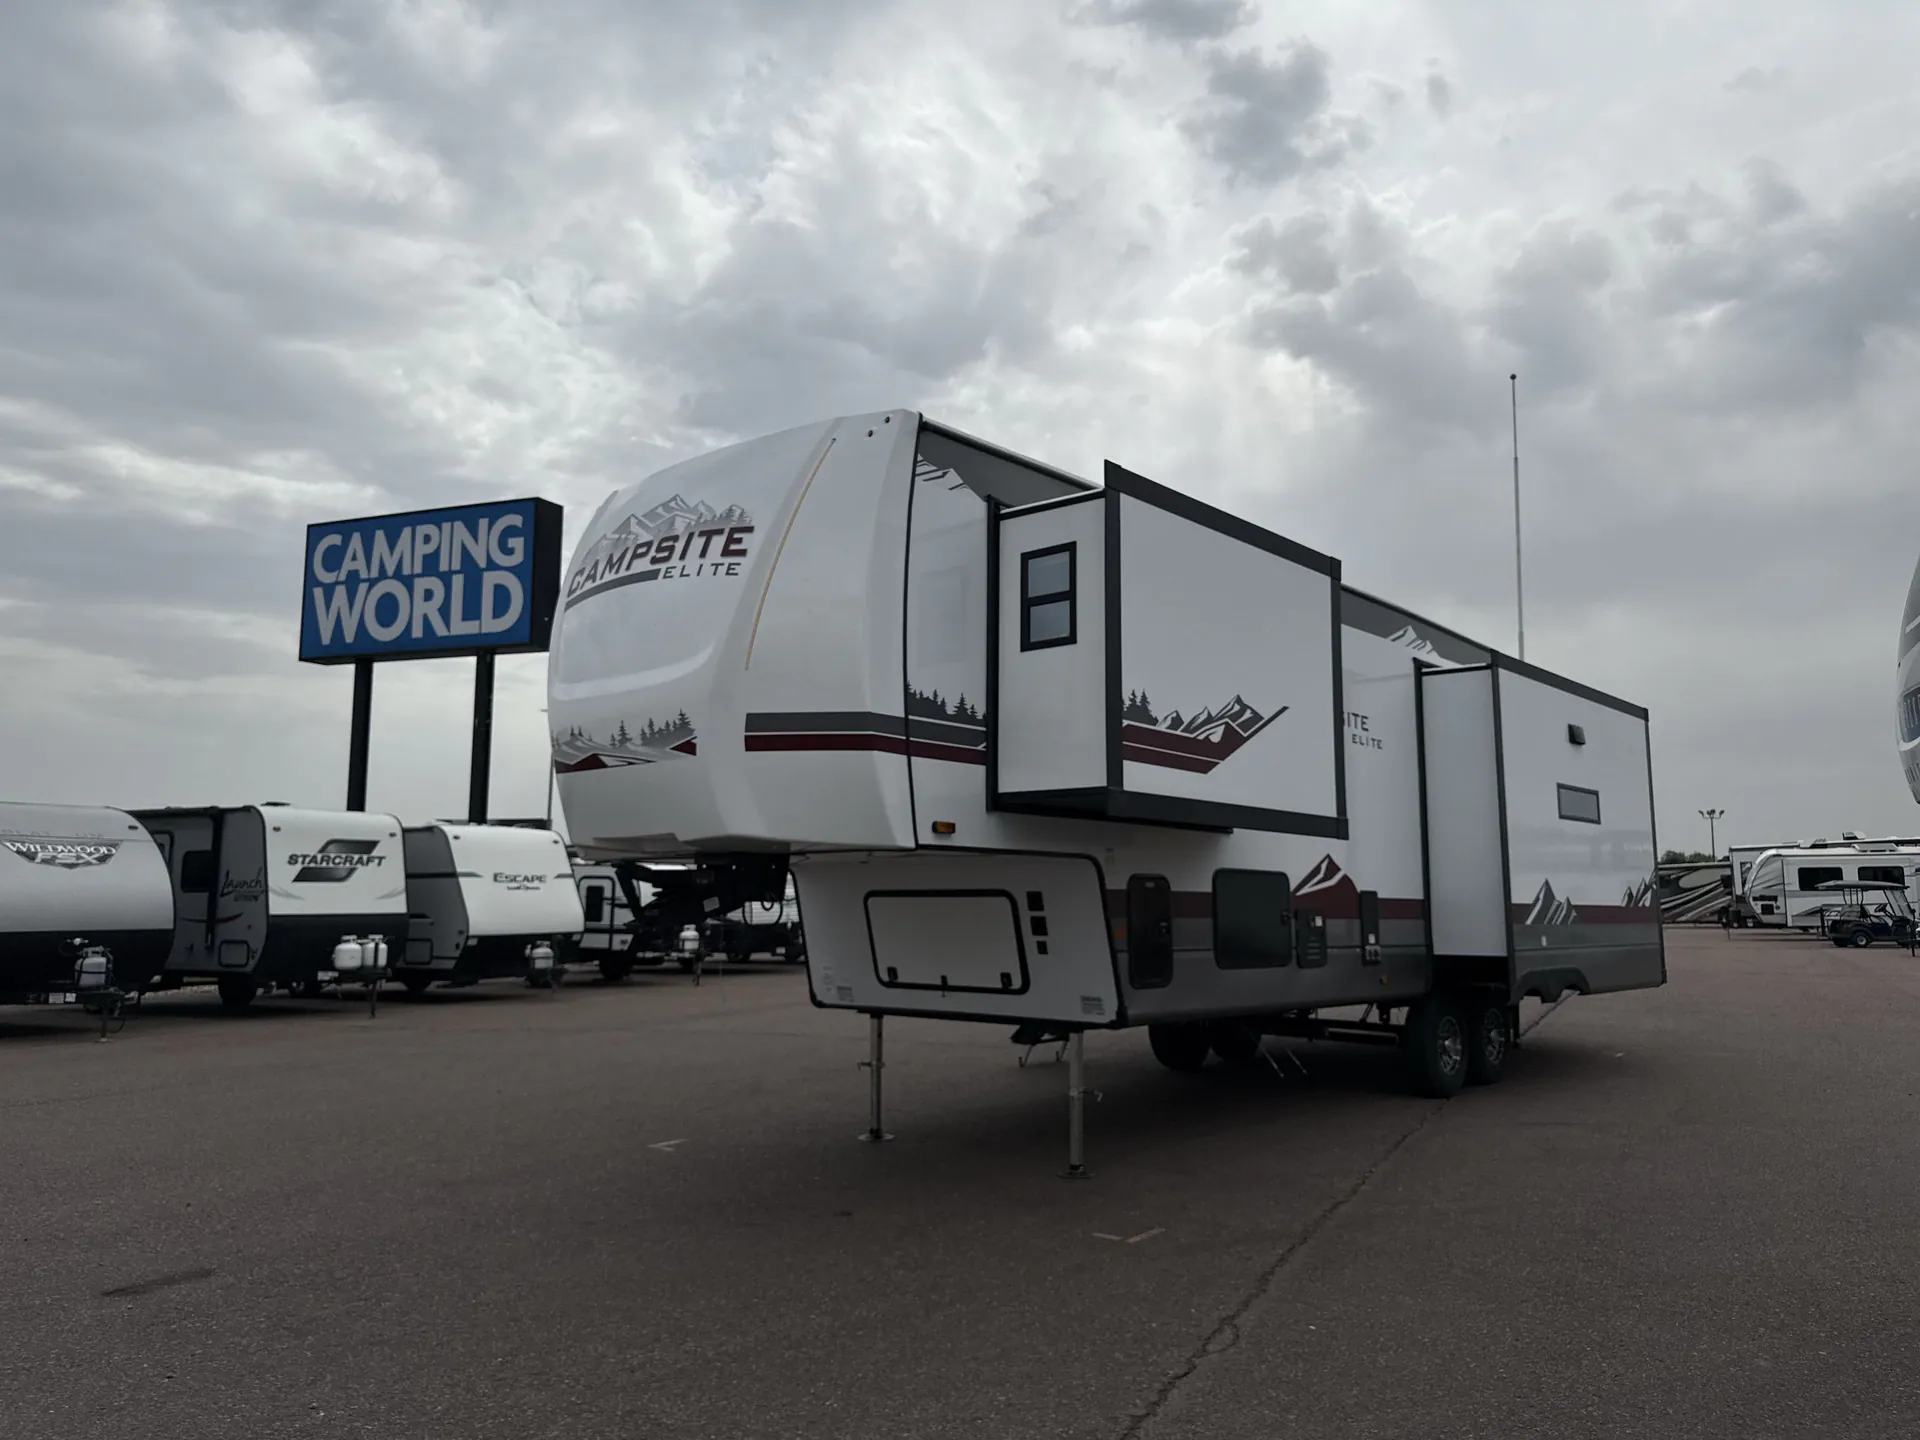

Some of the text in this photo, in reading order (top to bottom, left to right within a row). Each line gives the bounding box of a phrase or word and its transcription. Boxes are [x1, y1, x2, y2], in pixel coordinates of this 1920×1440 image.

[313, 514, 524, 584] CAMPING
[567, 525, 755, 598] CAMPSITE
[662, 562, 743, 580] ELITE
[313, 570, 524, 646] WORLD
[1343, 711, 1369, 732] ITE
[1351, 733, 1383, 750] ELITE
[3, 841, 116, 855] WILDWOOD
[34, 852, 103, 864] FSX
[287, 853, 386, 867] STARCRAFT
[493, 872, 547, 884] ESCAPE
